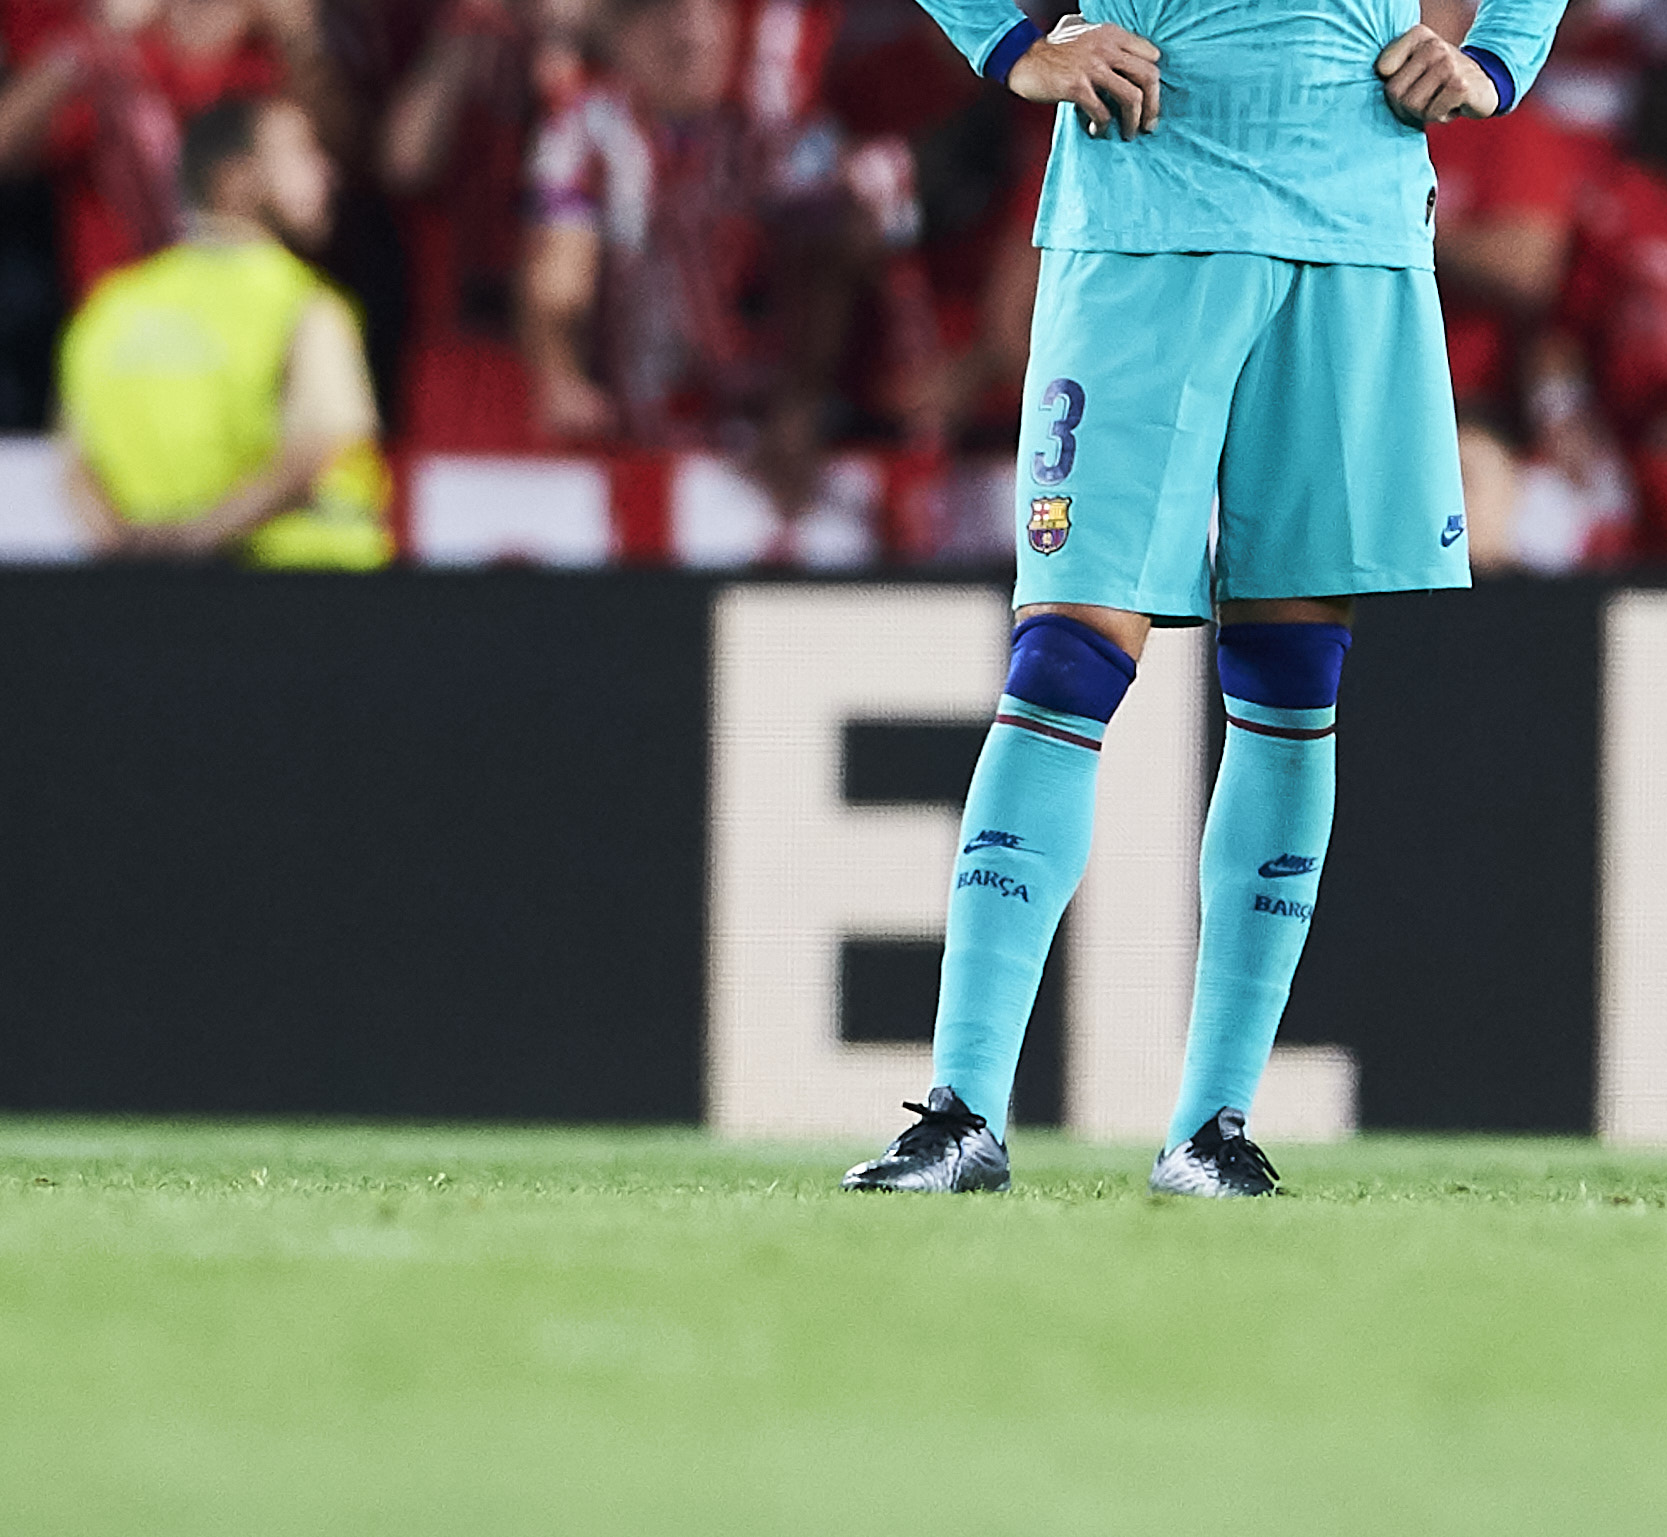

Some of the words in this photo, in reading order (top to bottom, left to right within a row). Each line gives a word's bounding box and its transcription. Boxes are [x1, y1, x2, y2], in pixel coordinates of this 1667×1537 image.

[1031, 378, 1086, 487] 3
[704, 582, 1361, 1142] EL
[957, 869, 1029, 903] BARÇA
